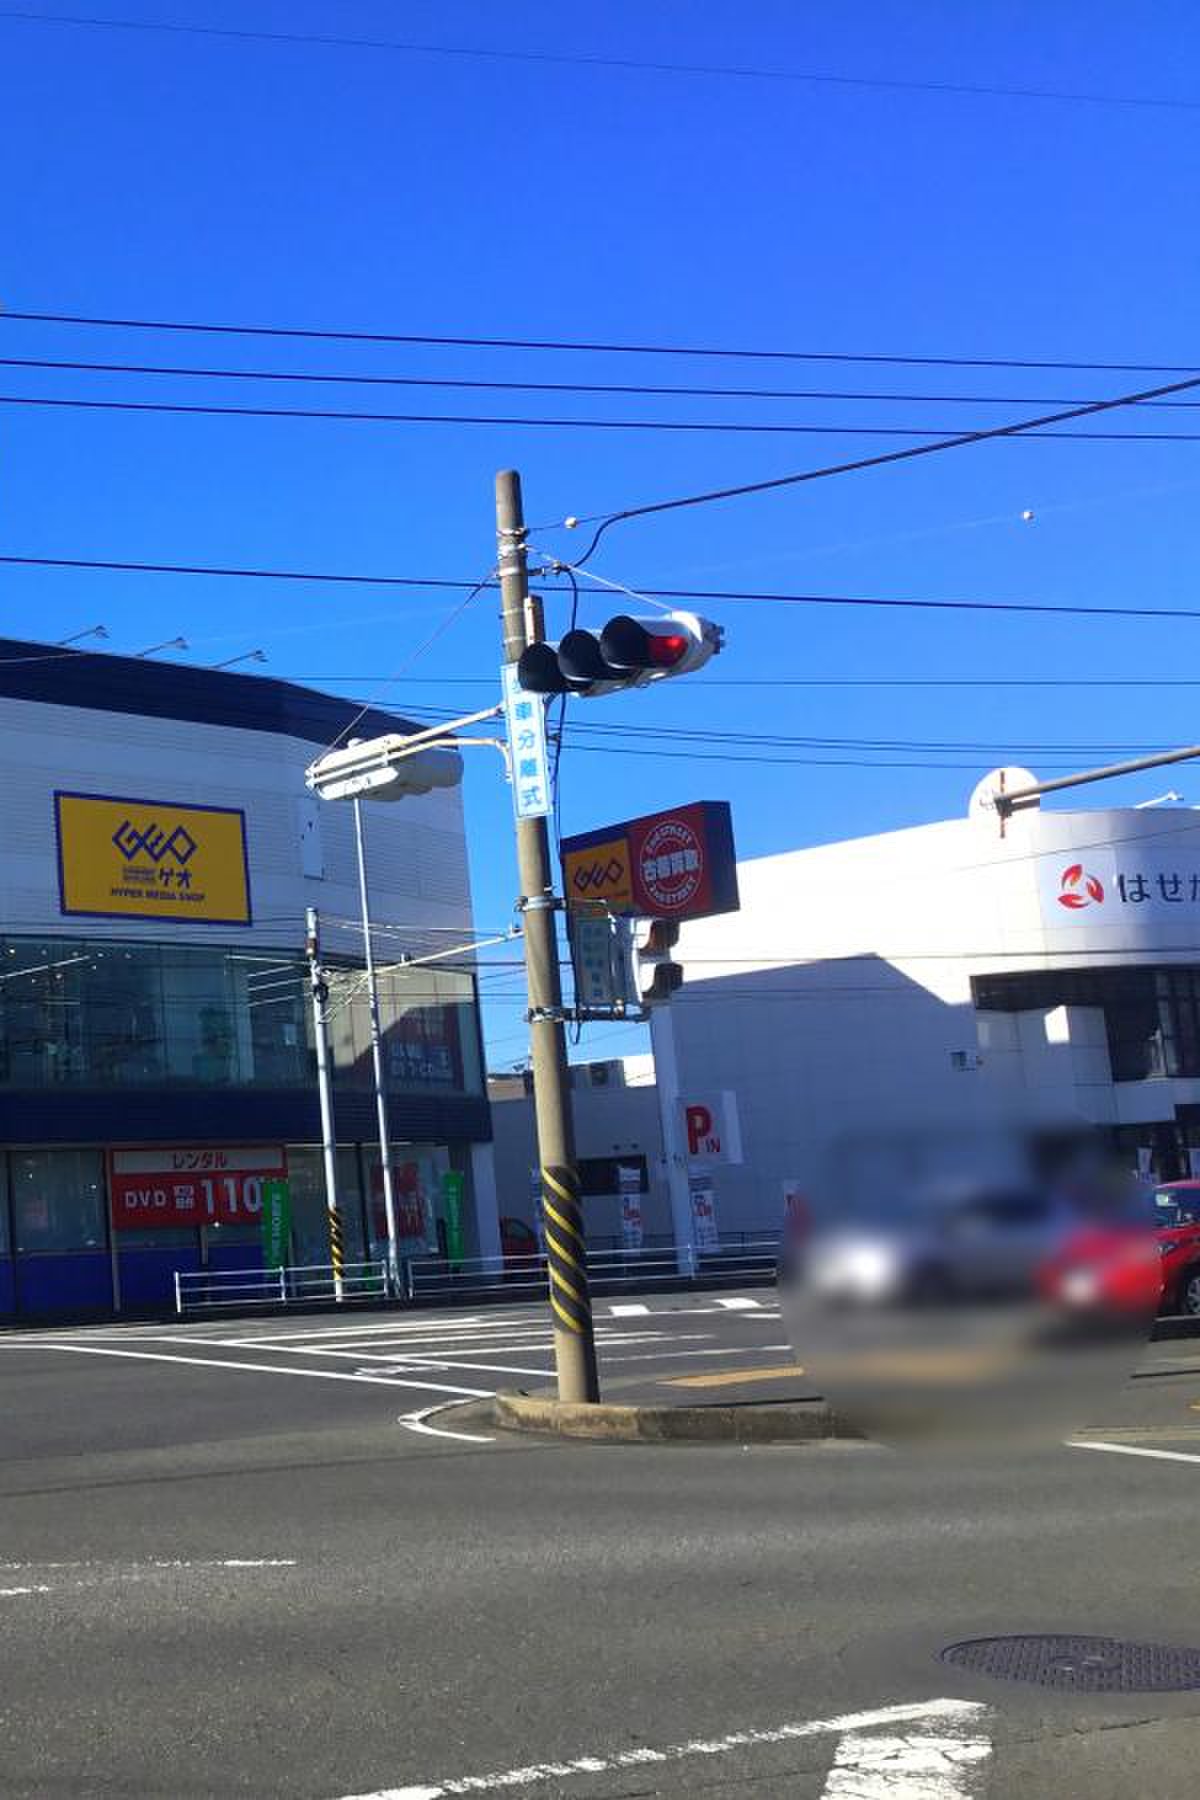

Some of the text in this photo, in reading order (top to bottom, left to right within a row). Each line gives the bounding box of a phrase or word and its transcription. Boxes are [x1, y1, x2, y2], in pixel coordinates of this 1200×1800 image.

[112, 820, 197, 865] GEO
[687, 1106, 712, 1154] P
[125, 1189, 167, 1209] DVD
